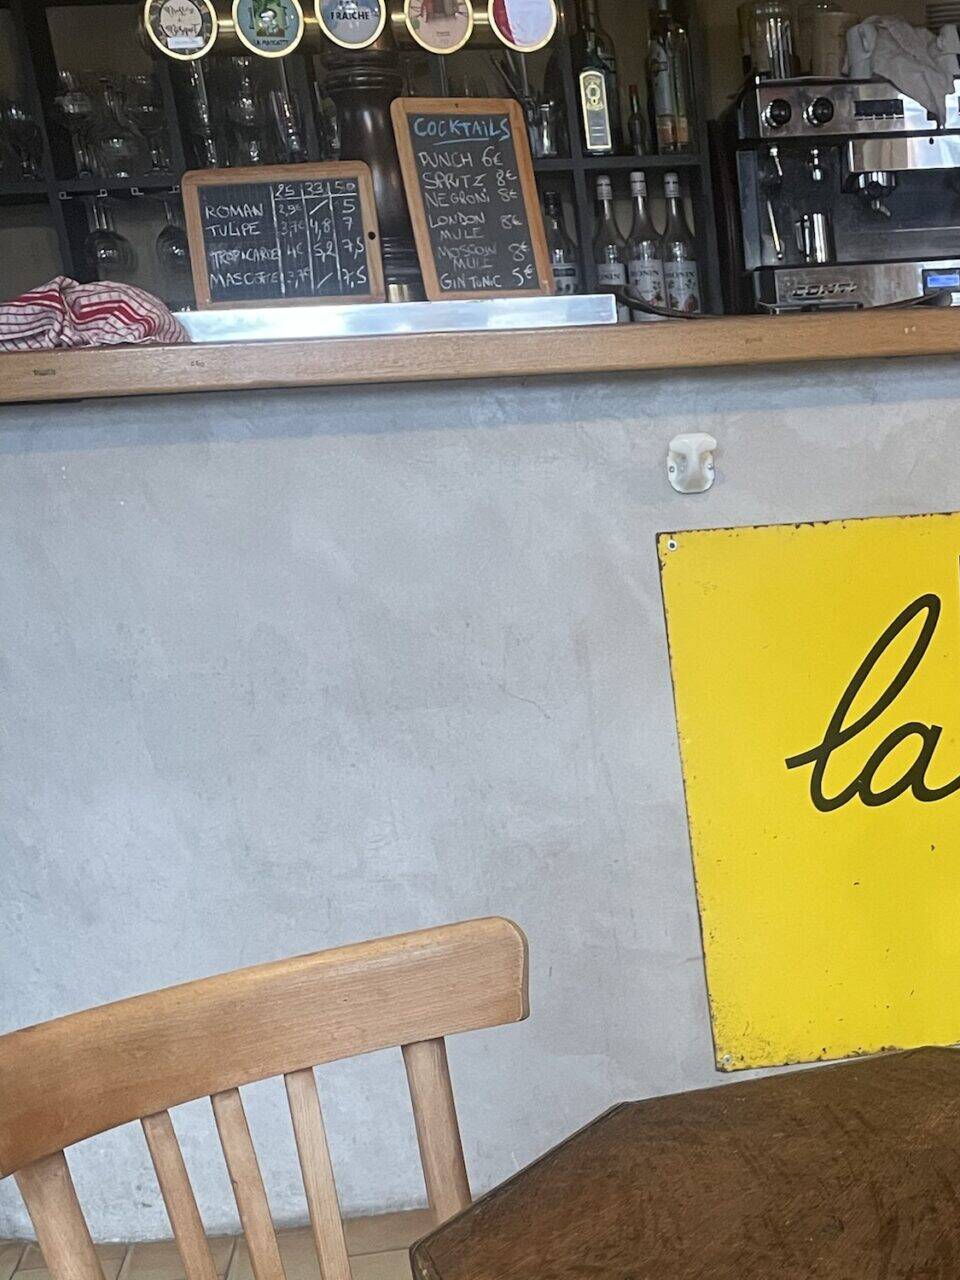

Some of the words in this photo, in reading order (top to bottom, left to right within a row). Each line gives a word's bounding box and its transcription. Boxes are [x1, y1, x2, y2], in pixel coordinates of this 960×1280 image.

[419, 152, 473, 168] PUNCH
[482, 146, 504, 167] 6€
[423, 172, 486, 190] SPRITZ
[275, 184, 295, 197] 25
[205, 203, 263, 219] ROMAN
[342, 199, 356, 213] 5
[206, 221, 261, 237] TULIPE
[343, 217, 353, 231] 7
[428, 212, 485, 228] LONDON
[439, 227, 485, 240] MULE
[440, 273, 466, 289] GIN
